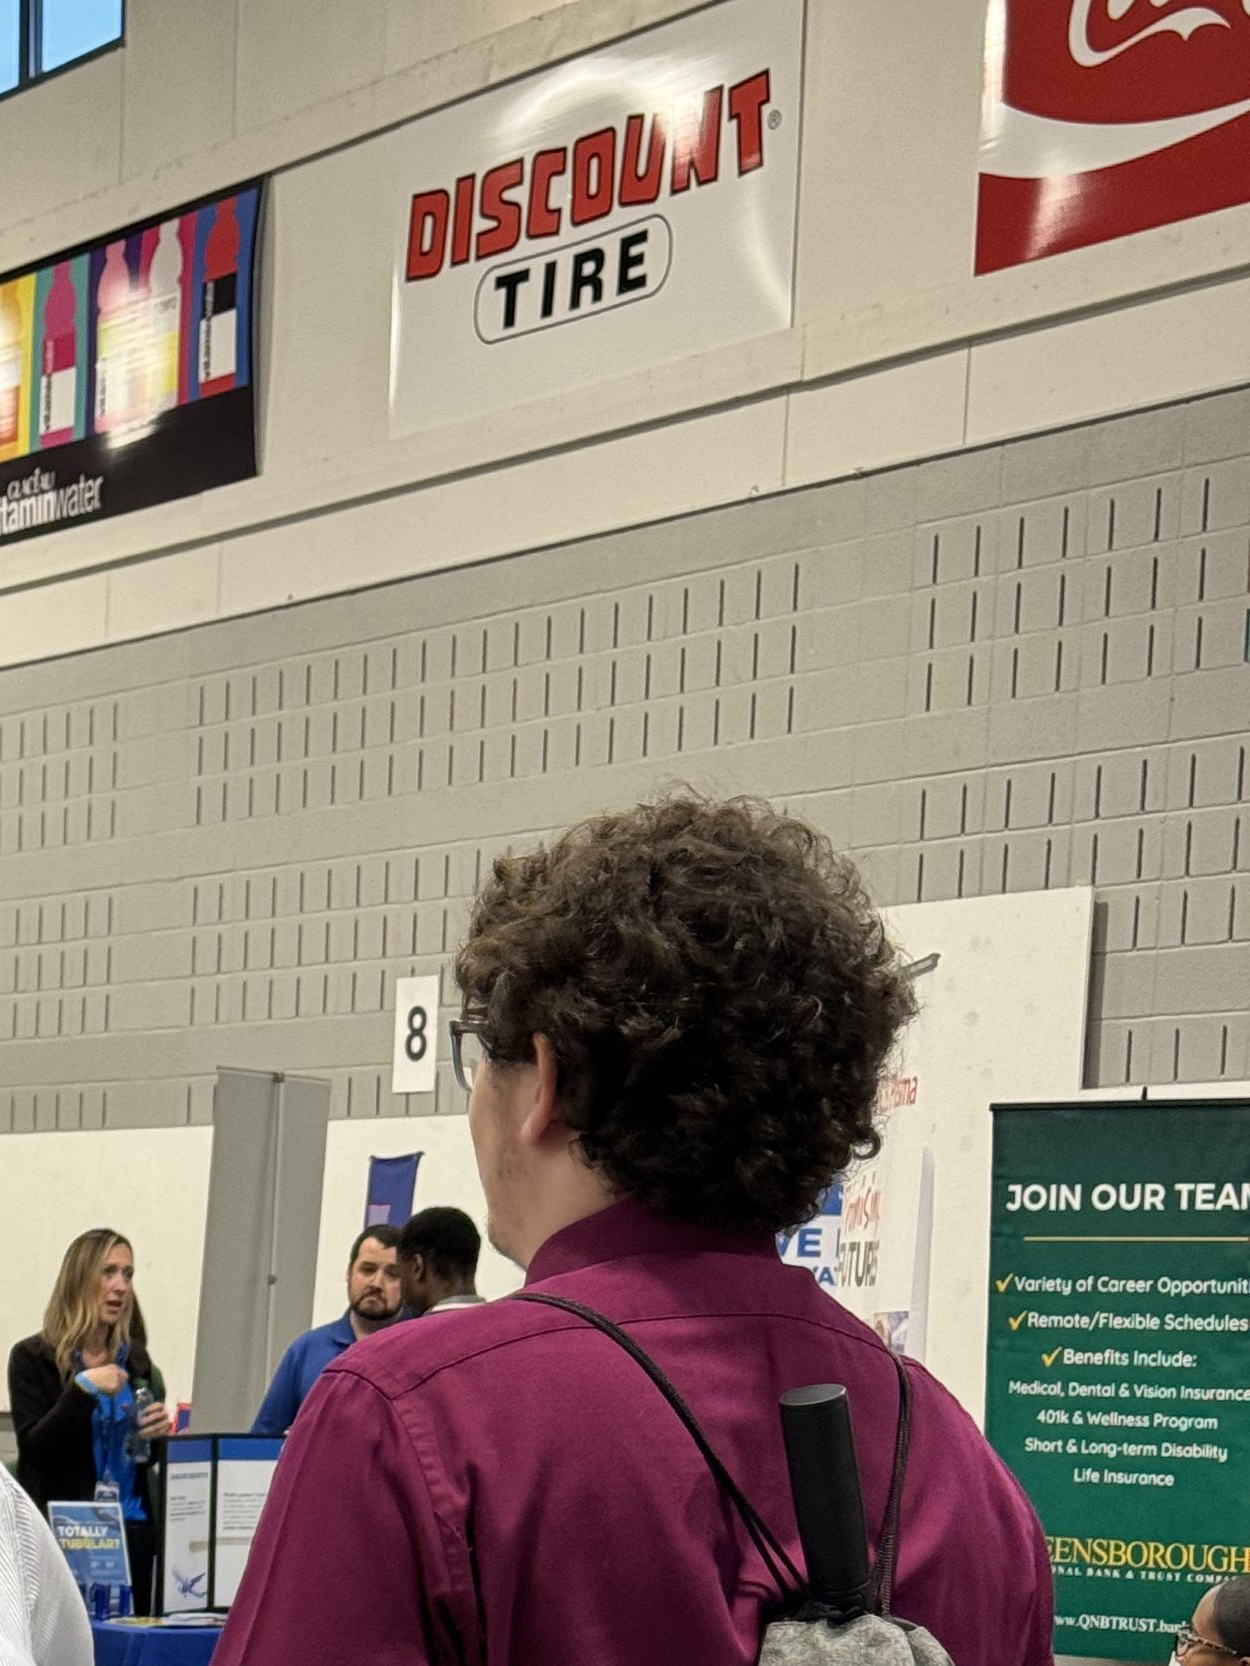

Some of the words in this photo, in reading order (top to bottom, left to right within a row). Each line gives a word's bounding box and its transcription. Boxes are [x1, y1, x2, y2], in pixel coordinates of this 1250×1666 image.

[405, 68, 770, 282] DISCOUNT
[495, 229, 648, 329] TIRE
[405, 1006, 427, 1062] 8
[1006, 1184, 1082, 1211] JOIN
[1091, 1184, 1166, 1211] OUR
[1014, 1276, 1072, 1295] Variety
[1076, 1276, 1094, 1292] of
[1097, 1276, 1153, 1293] Career
[1028, 1312, 1160, 1331] Remote/Flexible
[1164, 1314, 1248, 1331] Schedules
[1063, 1349, 1129, 1366] Benefits
[1133, 1350, 1197, 1367] Include:
[1009, 1381, 1064, 1397] Medical,
[1068, 1382, 1115, 1398] Dental
[1119, 1383, 1131, 1398] &
[1134, 1383, 1176, 1399] Vision
[1181, 1386, 1250, 1401] Insurance
[1037, 1410, 1068, 1424] 401k
[1072, 1411, 1083, 1425] &
[1087, 1412, 1149, 1427] Wellness
[1153, 1413, 1218, 1431] Program
[1025, 1437, 1062, 1453] Short
[1066, 1439, 1077, 1453] &
[1081, 1440, 1157, 1458] Long-term
[1161, 1443, 1228, 1462] Disability
[1074, 1468, 1100, 1483] Life
[1104, 1469, 1174, 1486] Insurance
[57, 1526, 108, 1537] TOTALLY
[61, 1538, 121, 1550] TUBULAR?
[1048, 1536, 1250, 1573] ENSBOROUGH
[1086, 1568, 1120, 1578] BANK
[1125, 1569, 1135, 1579] &
[1140, 1570, 1181, 1581] TRUST
